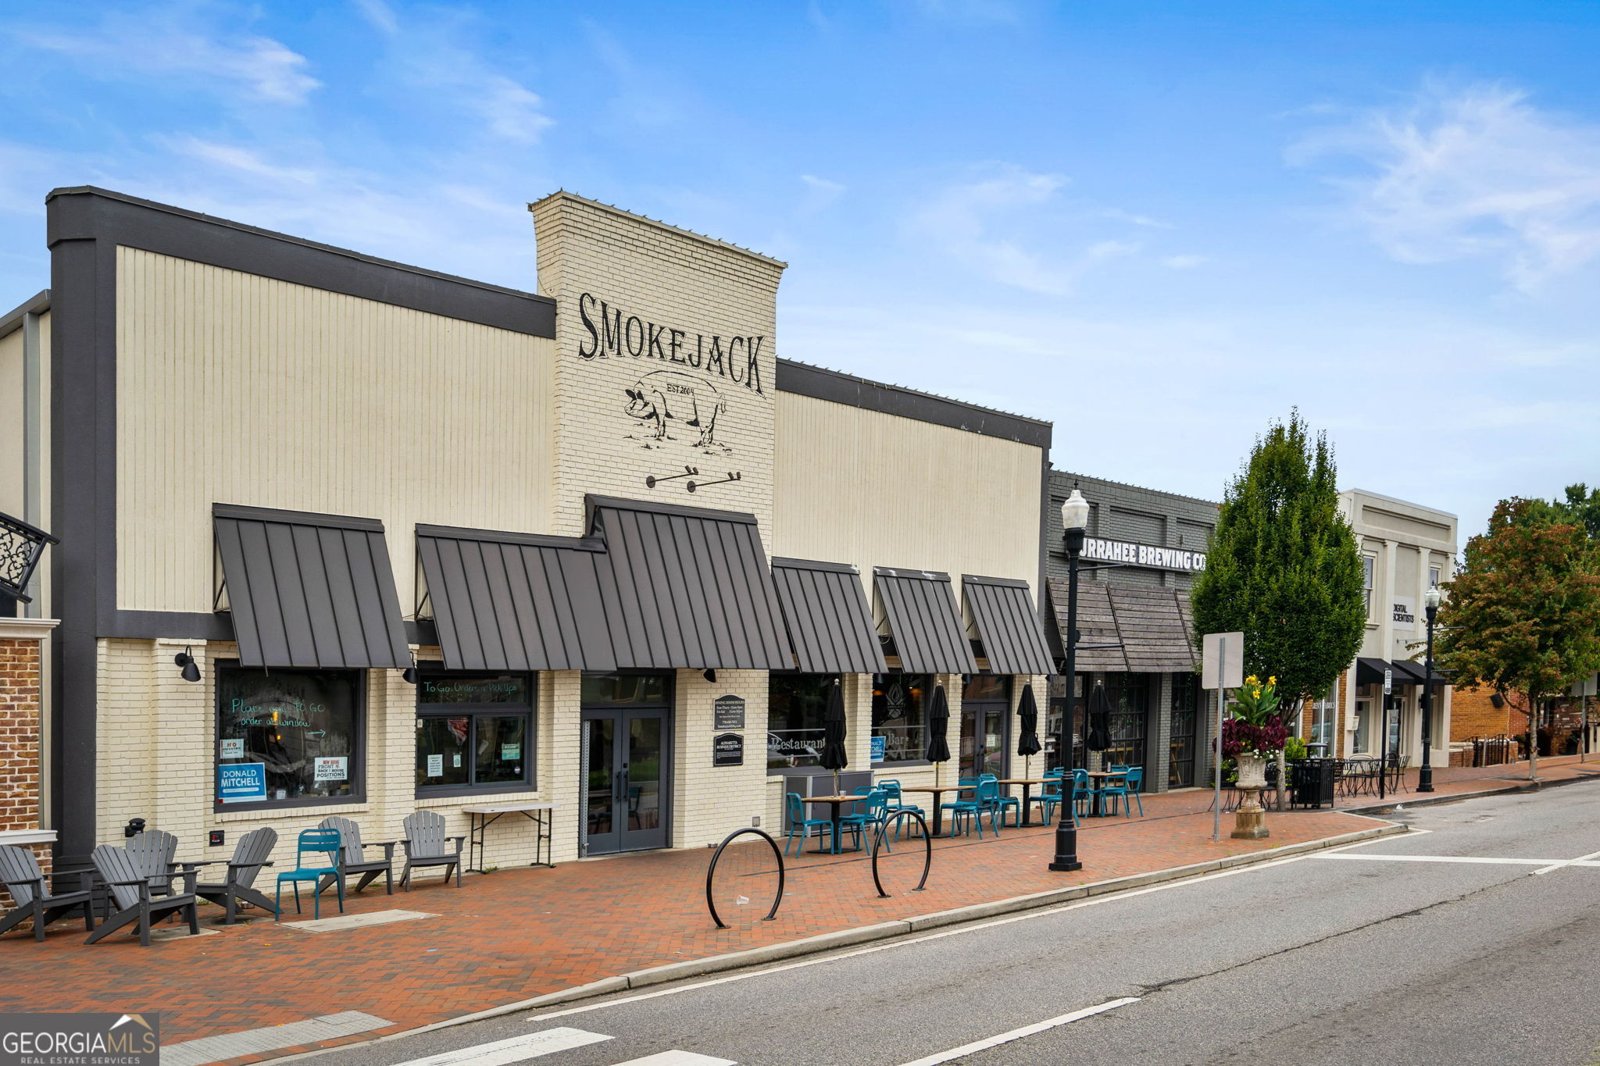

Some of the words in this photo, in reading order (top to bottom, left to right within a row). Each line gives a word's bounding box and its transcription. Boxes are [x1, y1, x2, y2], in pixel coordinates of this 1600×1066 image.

[578, 292, 765, 397] SMOKEJACK
[1079, 537, 1137, 562] URRAHEE
[1138, 545, 1191, 569] BREWING
[770, 736, 826, 750] Restaurant
[223, 769, 257, 778] DONALD
[221, 777, 260, 788] MITCHELL
